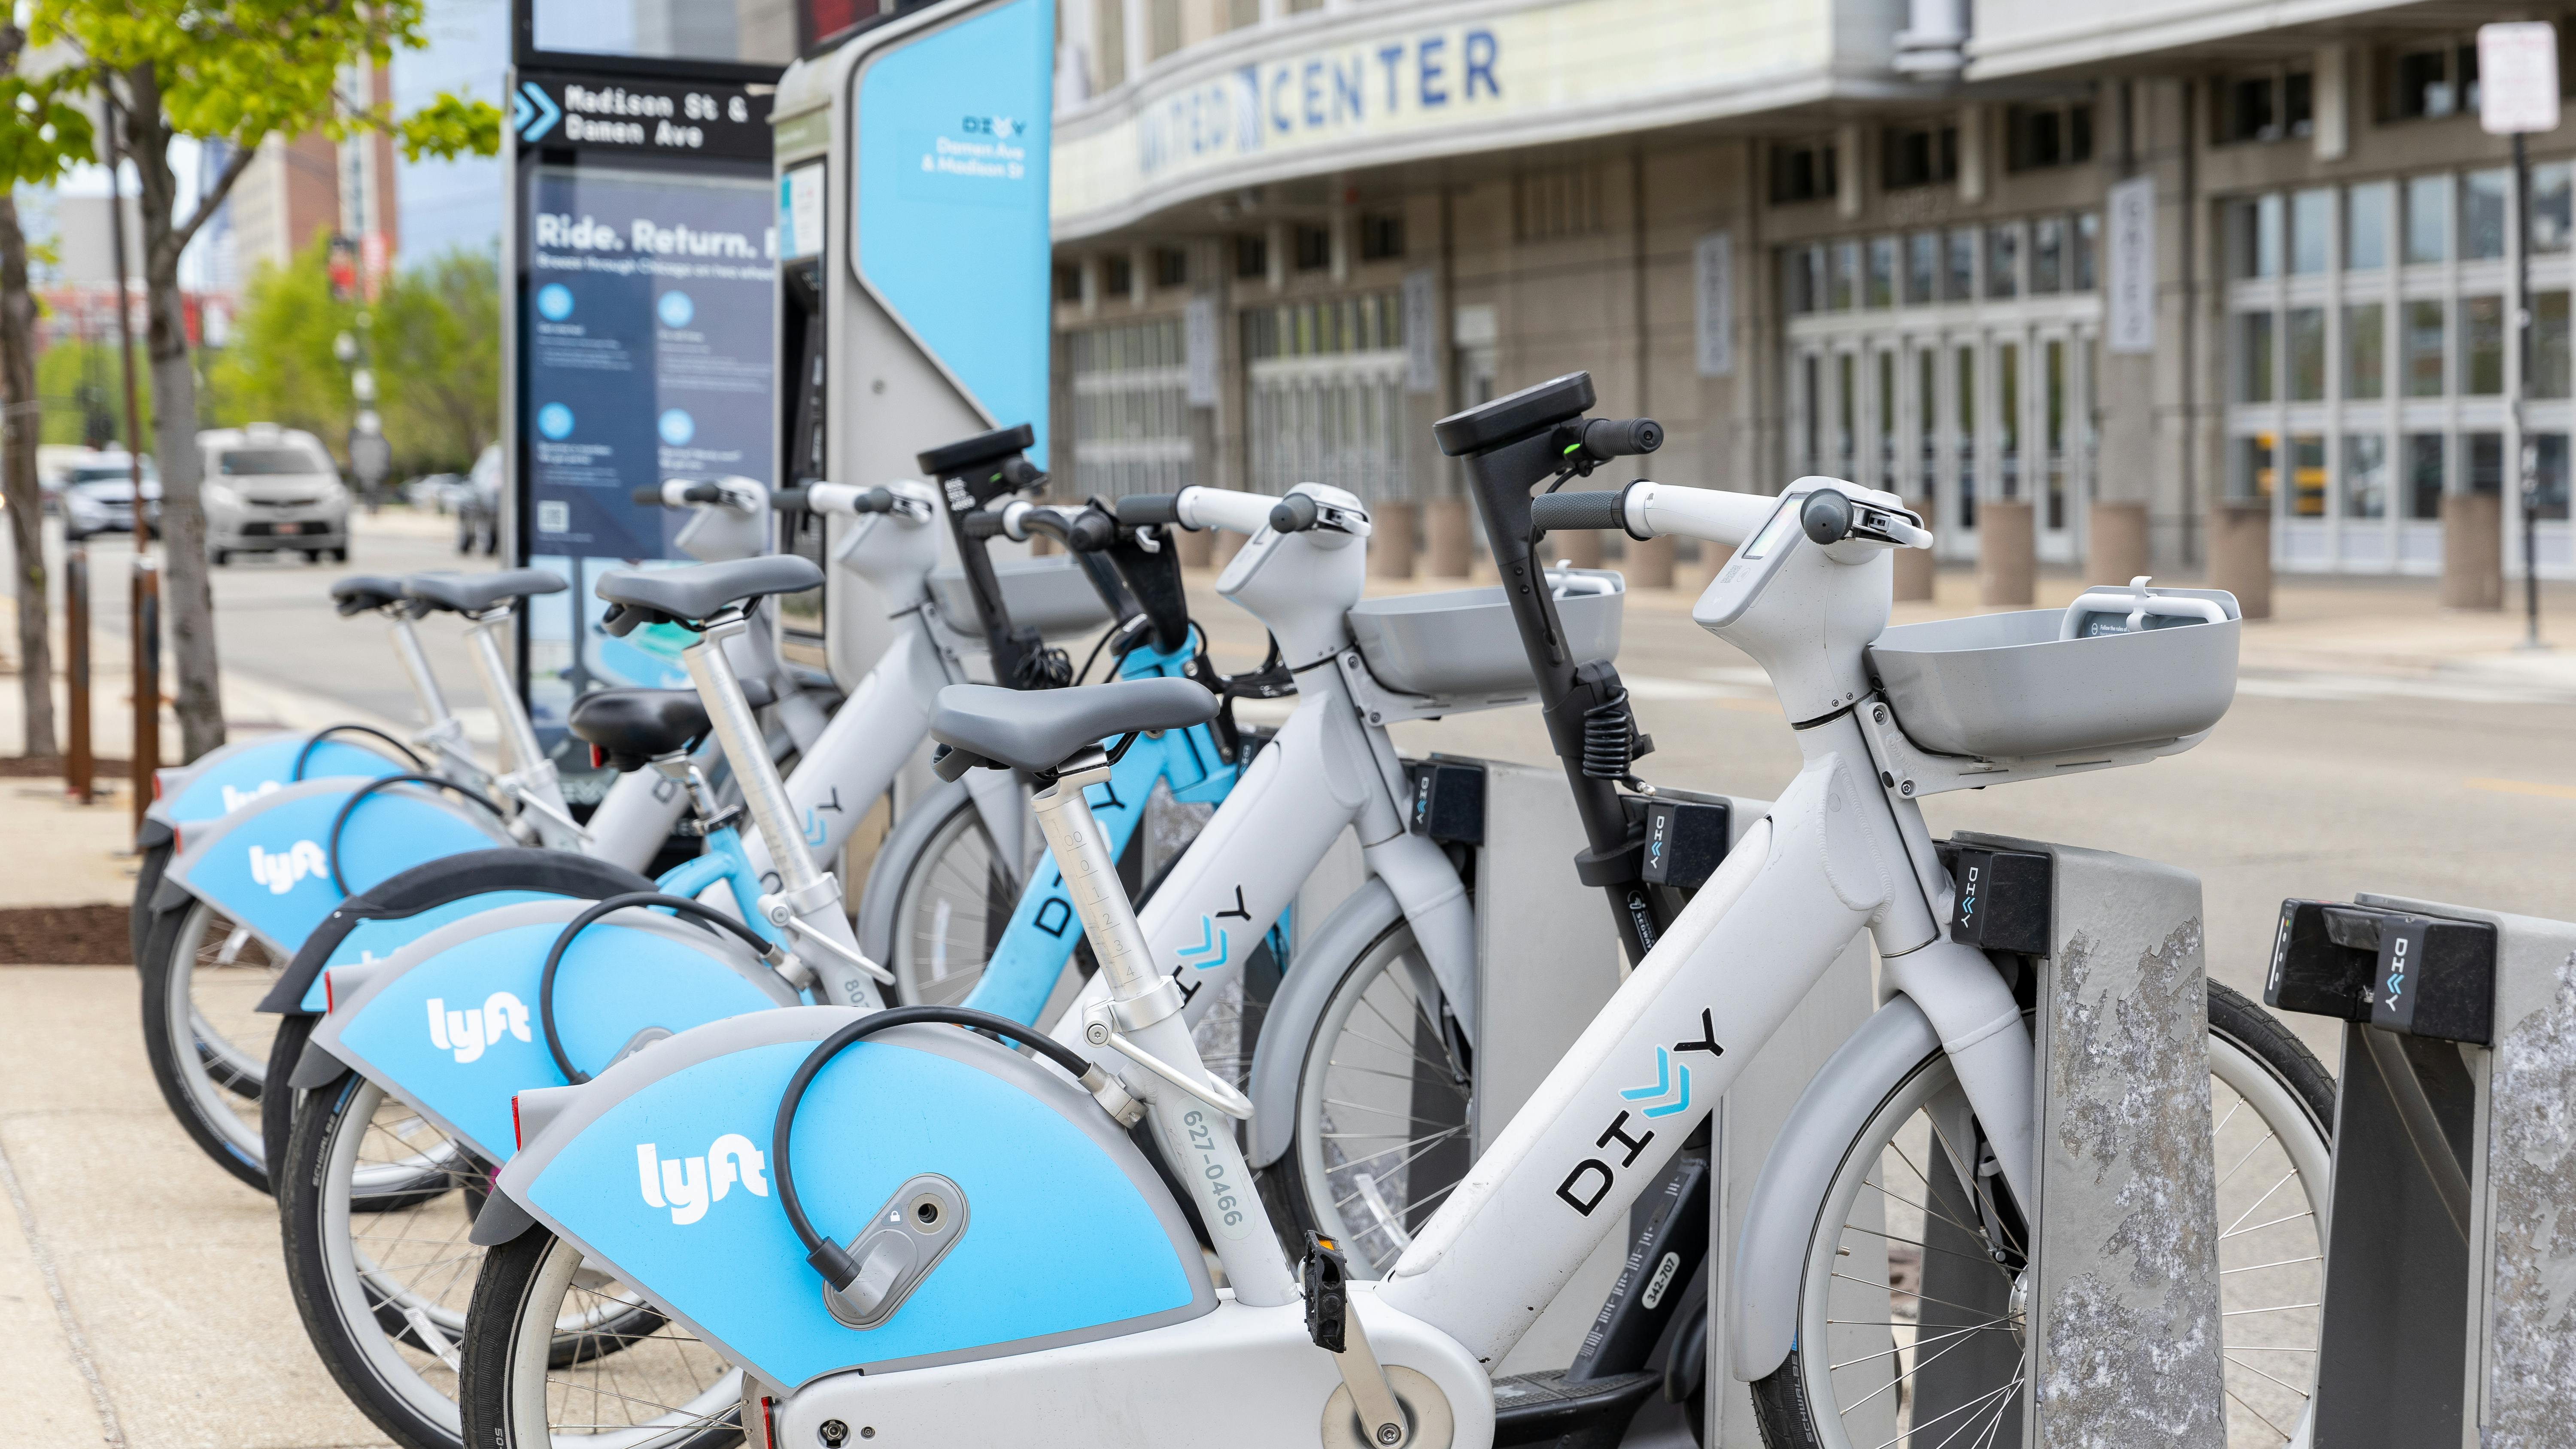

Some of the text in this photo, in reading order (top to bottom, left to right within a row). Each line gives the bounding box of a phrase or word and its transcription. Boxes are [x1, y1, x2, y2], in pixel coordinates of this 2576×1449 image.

[565, 85, 674, 117] Madison
[685, 92, 719, 121] St
[1270, 29, 1500, 133] CENTER
[565, 113, 703, 148] Damen Ave
[936, 135, 994, 156] Damen
[536, 213, 625, 251] Ride.
[631, 219, 758, 258] Return.
[1064, 831, 1083, 846] 00
[1650, 816, 1665, 869] DIVVY
[249, 839, 328, 895] lyft
[1080, 860, 1089, 871] 0
[1092, 887, 1099, 897] 1
[1961, 867, 1978, 928] DIVVY
[1103, 913, 1112, 925] 2
[1636, 912, 1653, 948] SEGWAY
[1114, 940, 1123, 951] 3
[1126, 965, 1135, 976] 4
[2385, 938, 2408, 1012] DIVVY
[427, 991, 532, 1063] lyft
[1555, 1008, 1724, 1217] DIVVY
[313, 1113, 336, 1188] SCHWALBE
[1183, 1110, 1242, 1227] 627-0466
[636, 1133, 769, 1225] lyft
[1647, 1257, 1676, 1303] 342-707
[1792, 1354, 1814, 1443] SCHWALBE
